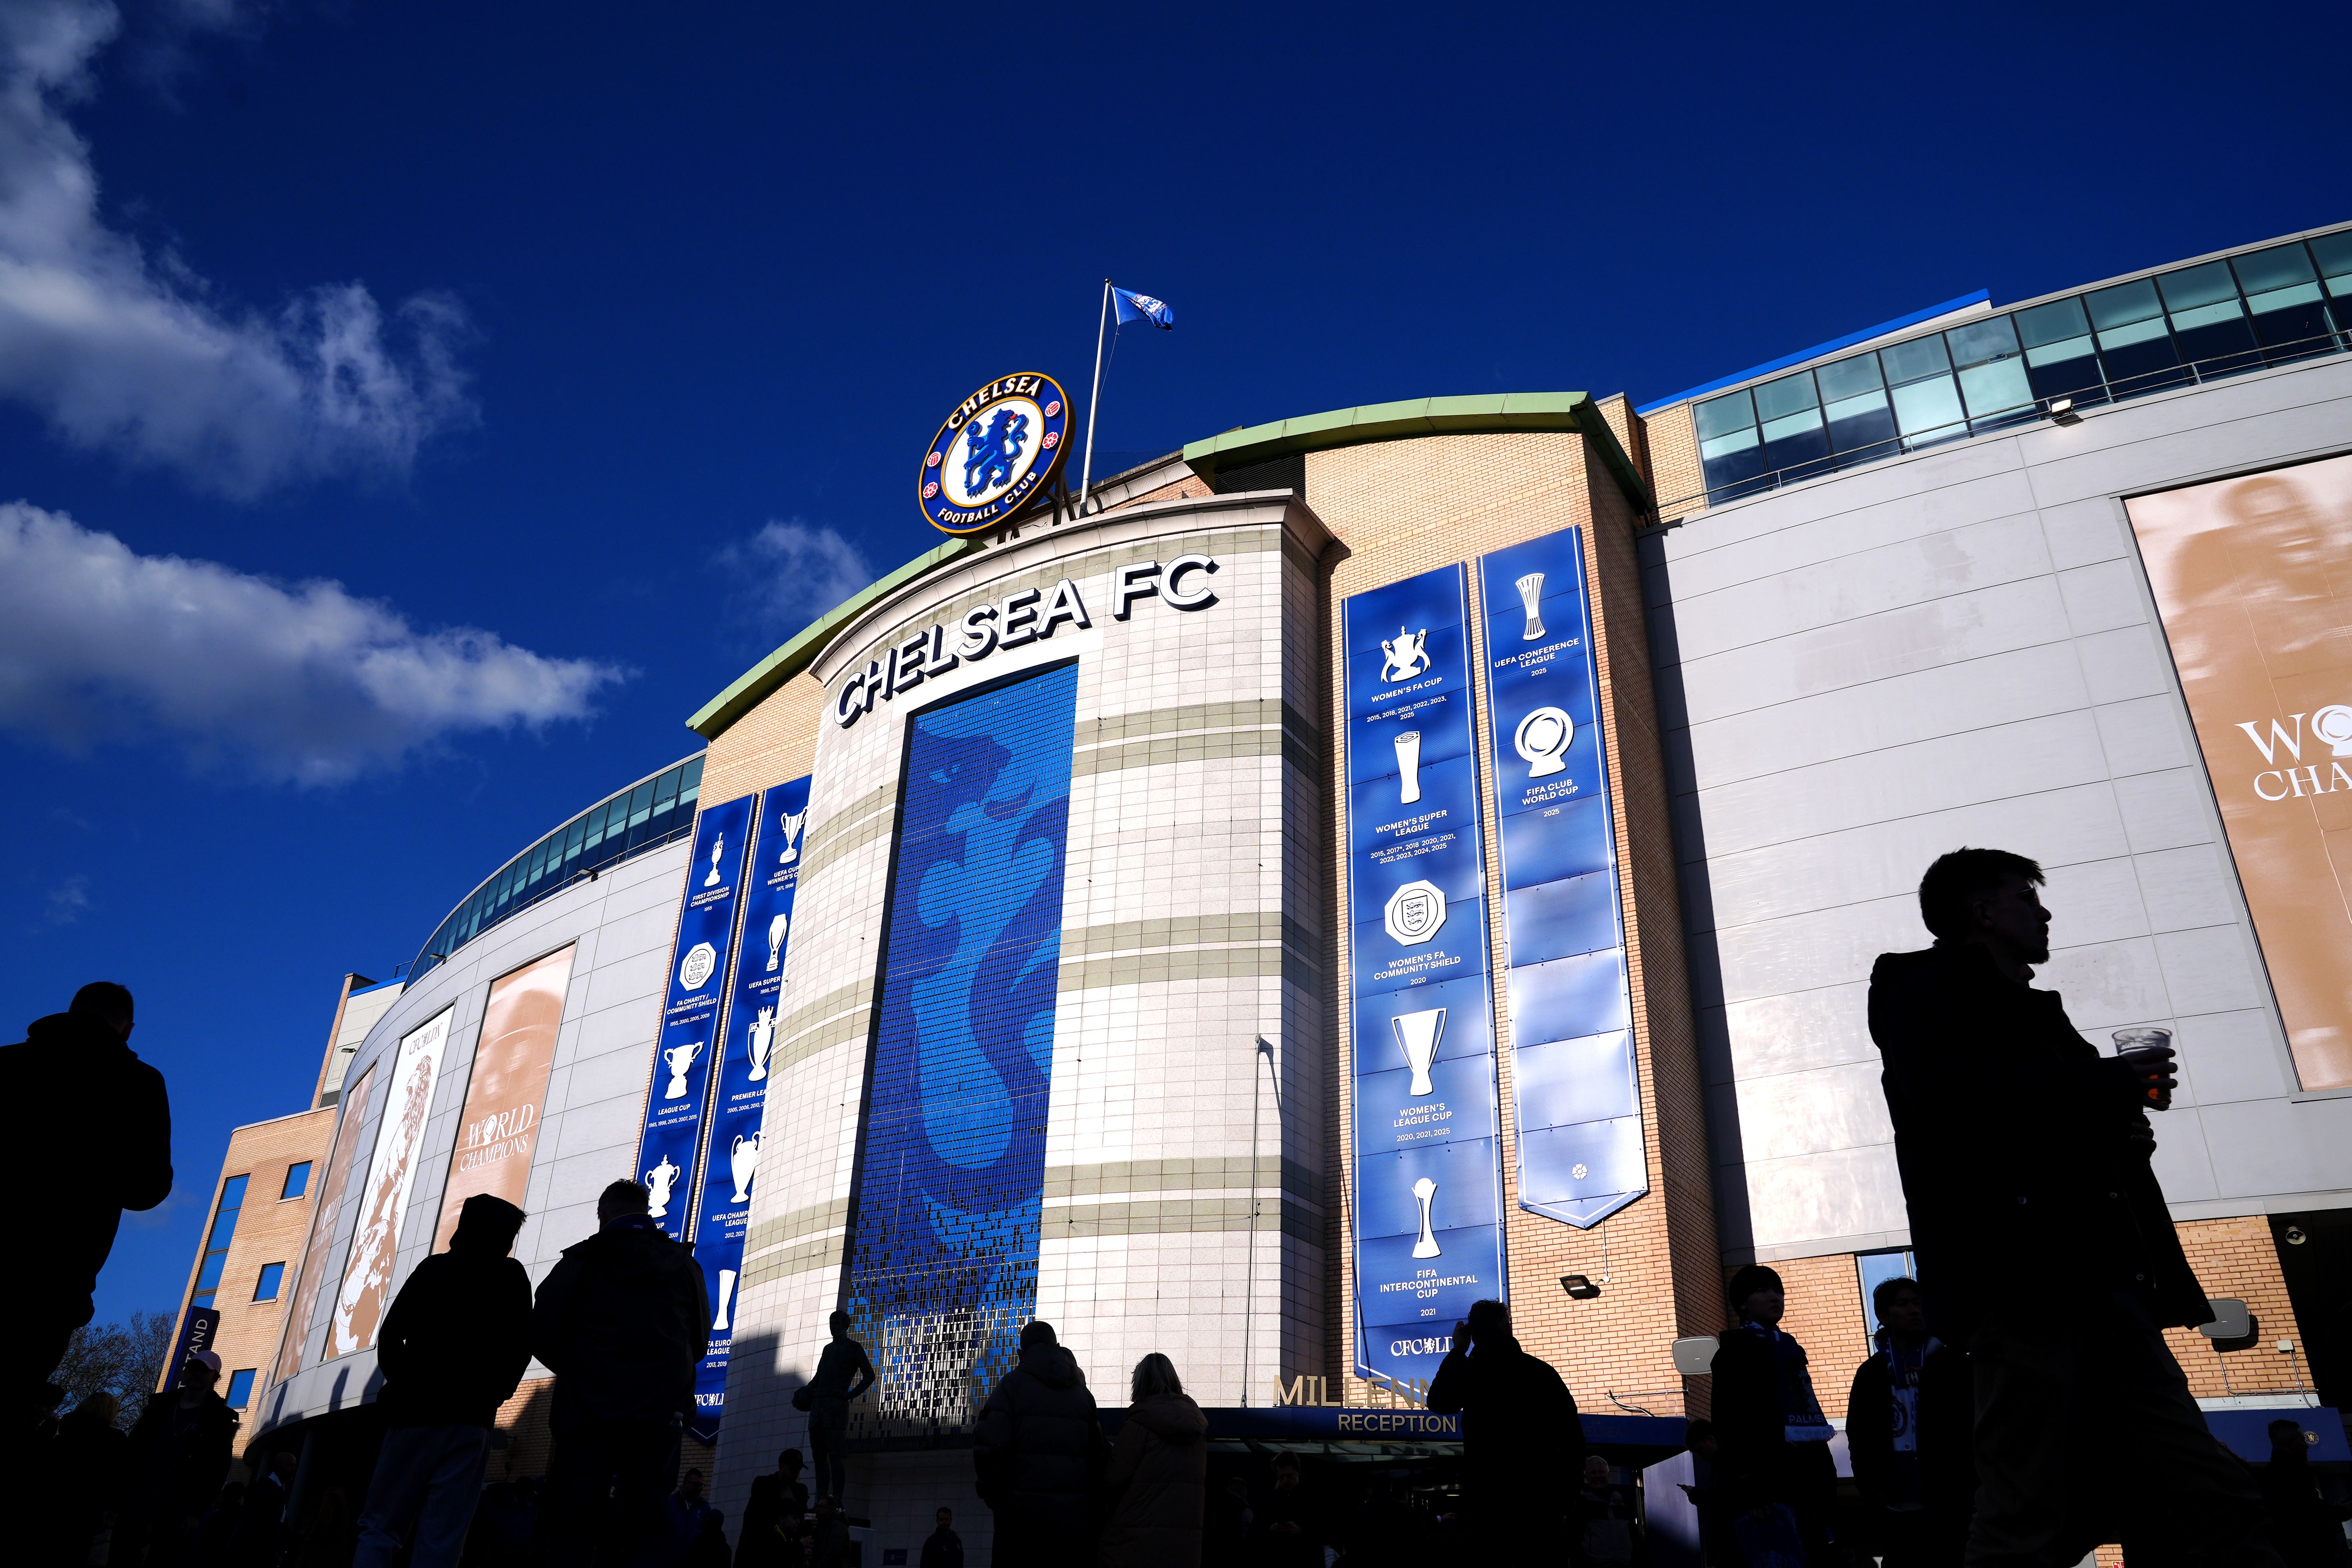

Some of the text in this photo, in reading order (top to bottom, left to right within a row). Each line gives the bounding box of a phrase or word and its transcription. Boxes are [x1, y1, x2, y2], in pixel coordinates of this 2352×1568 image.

[948, 376, 1042, 429] CHELSEA
[938, 472, 1037, 524] FOOTBALL CLUB
[834, 554, 1217, 728] CHELSEA FC
[1494, 638, 1579, 668] UEFA CONFERENCE
[1520, 652, 1556, 668] LEAGUE
[1531, 667, 1547, 676] 2025
[1371, 686, 1411, 703] WOMEN'S
[1424, 677, 1443, 687] CUP
[1367, 696, 1447, 723] 2015, 2018, 2021, 2022, 2023,
[1400, 711, 1415, 720] 2025
[1522, 786, 1579, 805] WORLD CUP
[1527, 779, 1573, 797] FIFA CLUB
[1543, 808, 1560, 817] 2025
[1375, 809, 1448, 834] WOMEN'S SUPER
[1395, 822, 1430, 837] LEAGUE
[1370, 850, 1386, 859] 2015,
[1405, 842, 1419, 851] 2018
[1422, 837, 1439, 847] 2020,
[1440, 833, 1456, 842] 2021,
[1380, 843, 1447, 864] 2022, 2023, 2024, 2025
[767, 873, 793, 885] WINNER'S
[774, 869, 787, 878] UEFA
[690, 892, 729, 907] CHAMPIONSHIP
[693, 886, 729, 901] FIRST DIVISION
[1374, 956, 1461, 980] COMMUNITY SHIELD
[1388, 951, 1446, 969] WOMEN'S FA
[749, 976, 781, 989] UEFA SUPER
[1410, 976, 1426, 985] 2020
[667, 998, 717, 1015] COMMUNITY SHIELD
[731, 1091, 756, 1102] PREMIER
[658, 1106, 679, 1115] LEAGUE
[1400, 1103, 1446, 1117] WOMEN'S
[1394, 1111, 1452, 1128] LEAGUE CUP
[1397, 1128, 1451, 1142] 2020, 2021, 2025
[460, 1134, 529, 1172] CHAMPIONS
[725, 1217, 748, 1227] LEAGUE
[1417, 1269, 1438, 1279] FIFA
[1380, 1275, 1478, 1293] INTERCONTINENTAL
[1417, 1289, 1438, 1299] CUP
[182, 1319, 208, 1371] TAND
[1338, 1414, 1456, 1433] RECEPTION
[1788, 1414, 1825, 1423] PALMER
